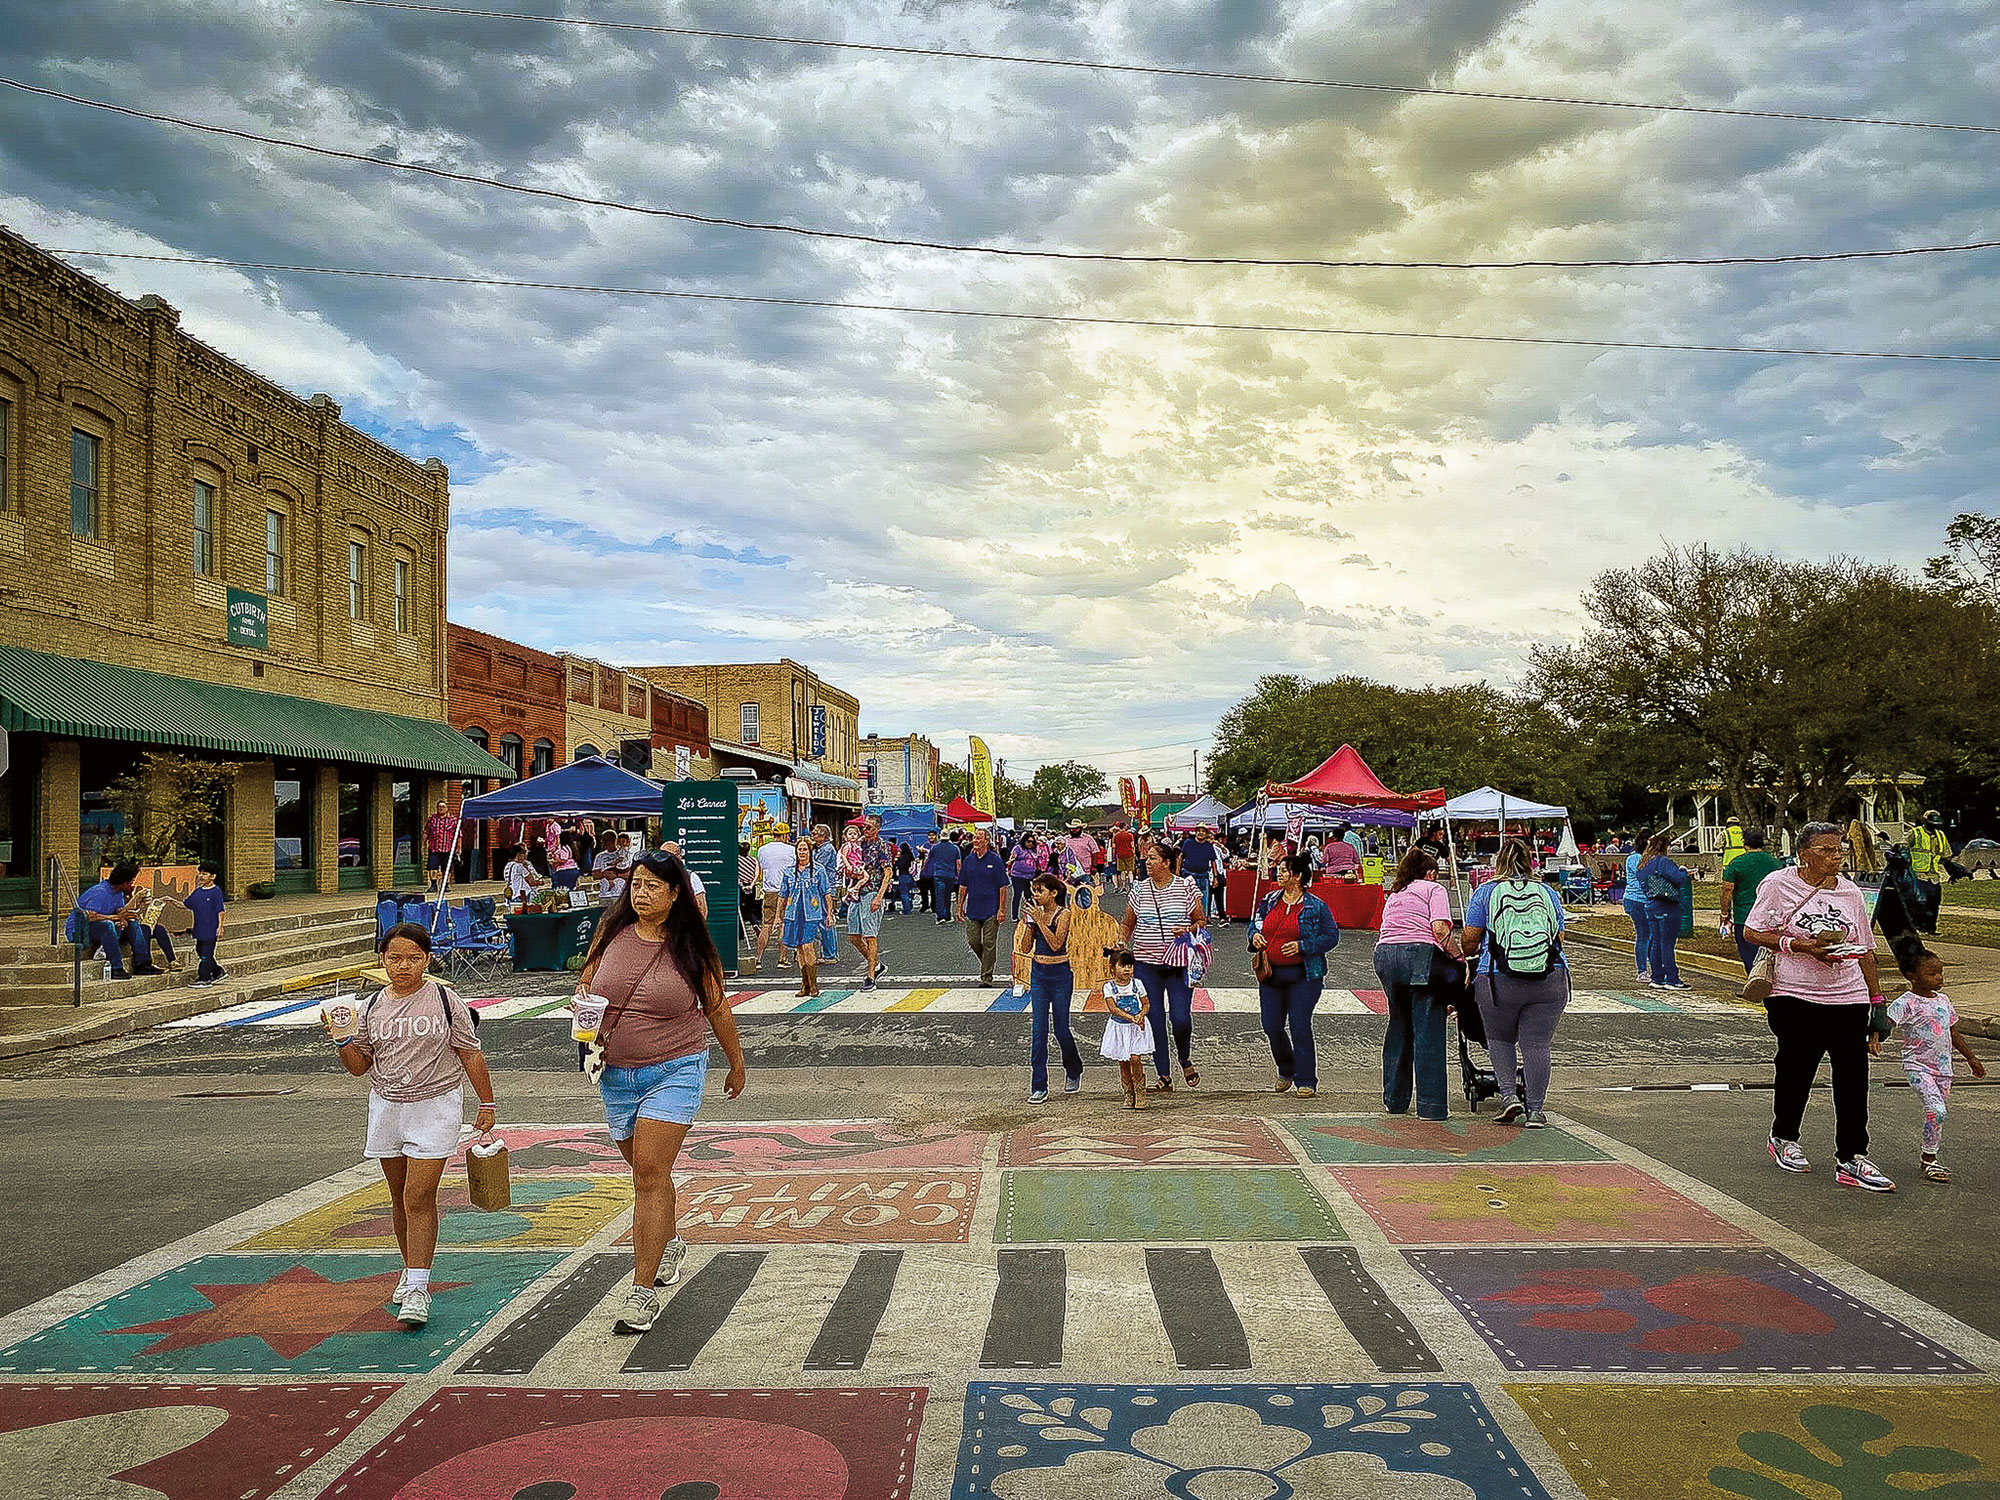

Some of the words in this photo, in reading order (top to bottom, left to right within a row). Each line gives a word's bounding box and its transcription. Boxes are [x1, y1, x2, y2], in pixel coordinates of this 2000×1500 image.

[230, 602, 266, 624] CUTBIRTH
[813, 707, 824, 753] JEWELRY
[677, 797, 695, 811] Let's
[696, 797, 728, 809] Connect
